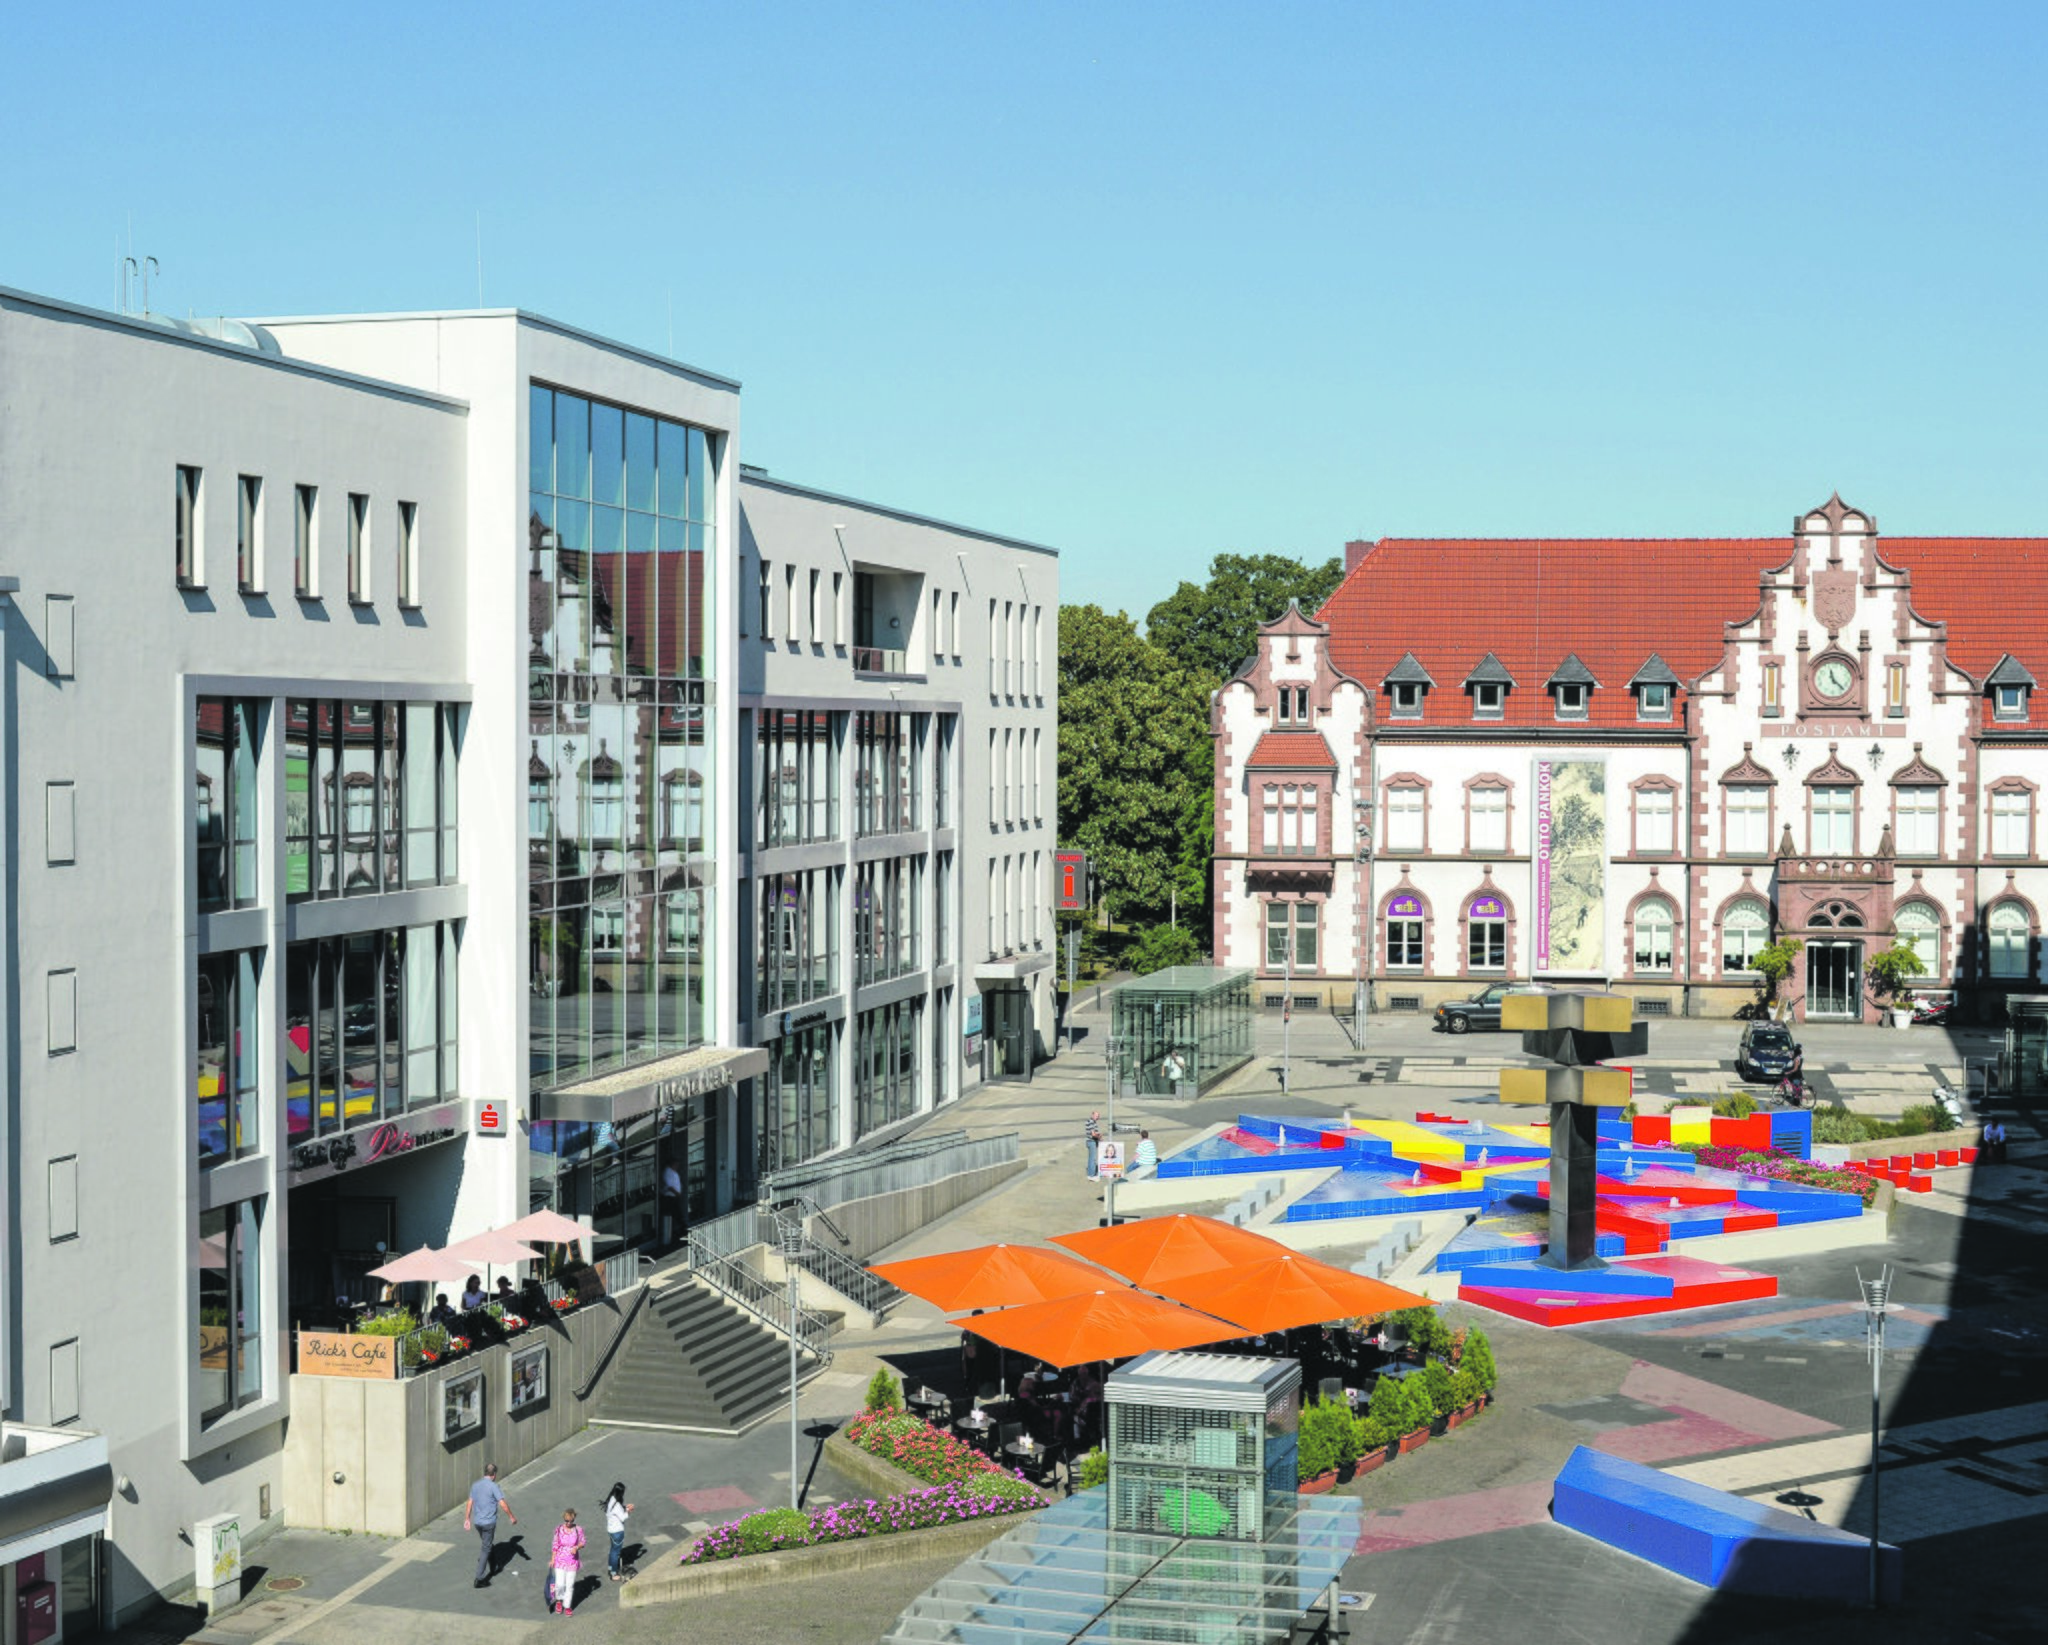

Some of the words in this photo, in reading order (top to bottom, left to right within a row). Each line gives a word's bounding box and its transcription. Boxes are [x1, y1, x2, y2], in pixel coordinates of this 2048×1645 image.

[1781, 725, 1886, 736] POSTAMT
[1539, 762, 1550, 819] PANKOK
[1539, 823, 1550, 860] OTTO
[306, 1340, 347, 1358] Rick's
[352, 1342, 388, 1366] Café
